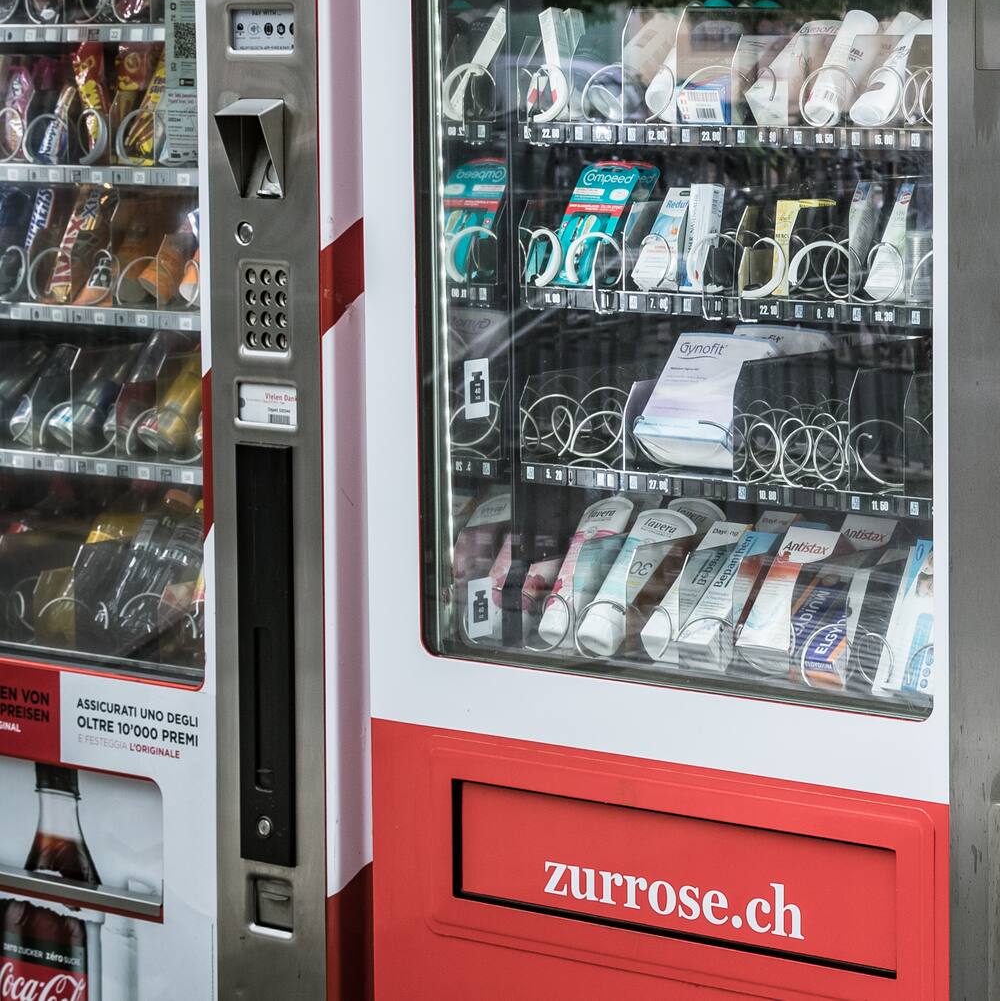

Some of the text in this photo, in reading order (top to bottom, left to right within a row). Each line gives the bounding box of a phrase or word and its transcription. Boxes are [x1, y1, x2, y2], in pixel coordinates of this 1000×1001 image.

[583, 169, 635, 185] Compeed
[680, 340, 726, 357] Gynofit
[264, 391, 283, 400] Vielen
[587, 507, 617, 519] lavera
[643, 517, 678, 535] lavera
[843, 527, 888, 543] Antistax
[783, 541, 830, 557] Antistax
[714, 535, 754, 589] Bepanthen
[22, 690, 50, 706] VON
[0, 704, 50, 722] PREISEN
[76, 697, 199, 728] ASSICURATI UNO DEGLI
[77, 715, 199, 747] OLTRE 10'000 PREMI
[78, 734, 181, 759] E FESTEGGIA L'ORIGINALE
[543, 860, 805, 940] zurrose.ch
[18, 946, 43, 958] ZUCKER
[45, 951, 63, 963] zéro
